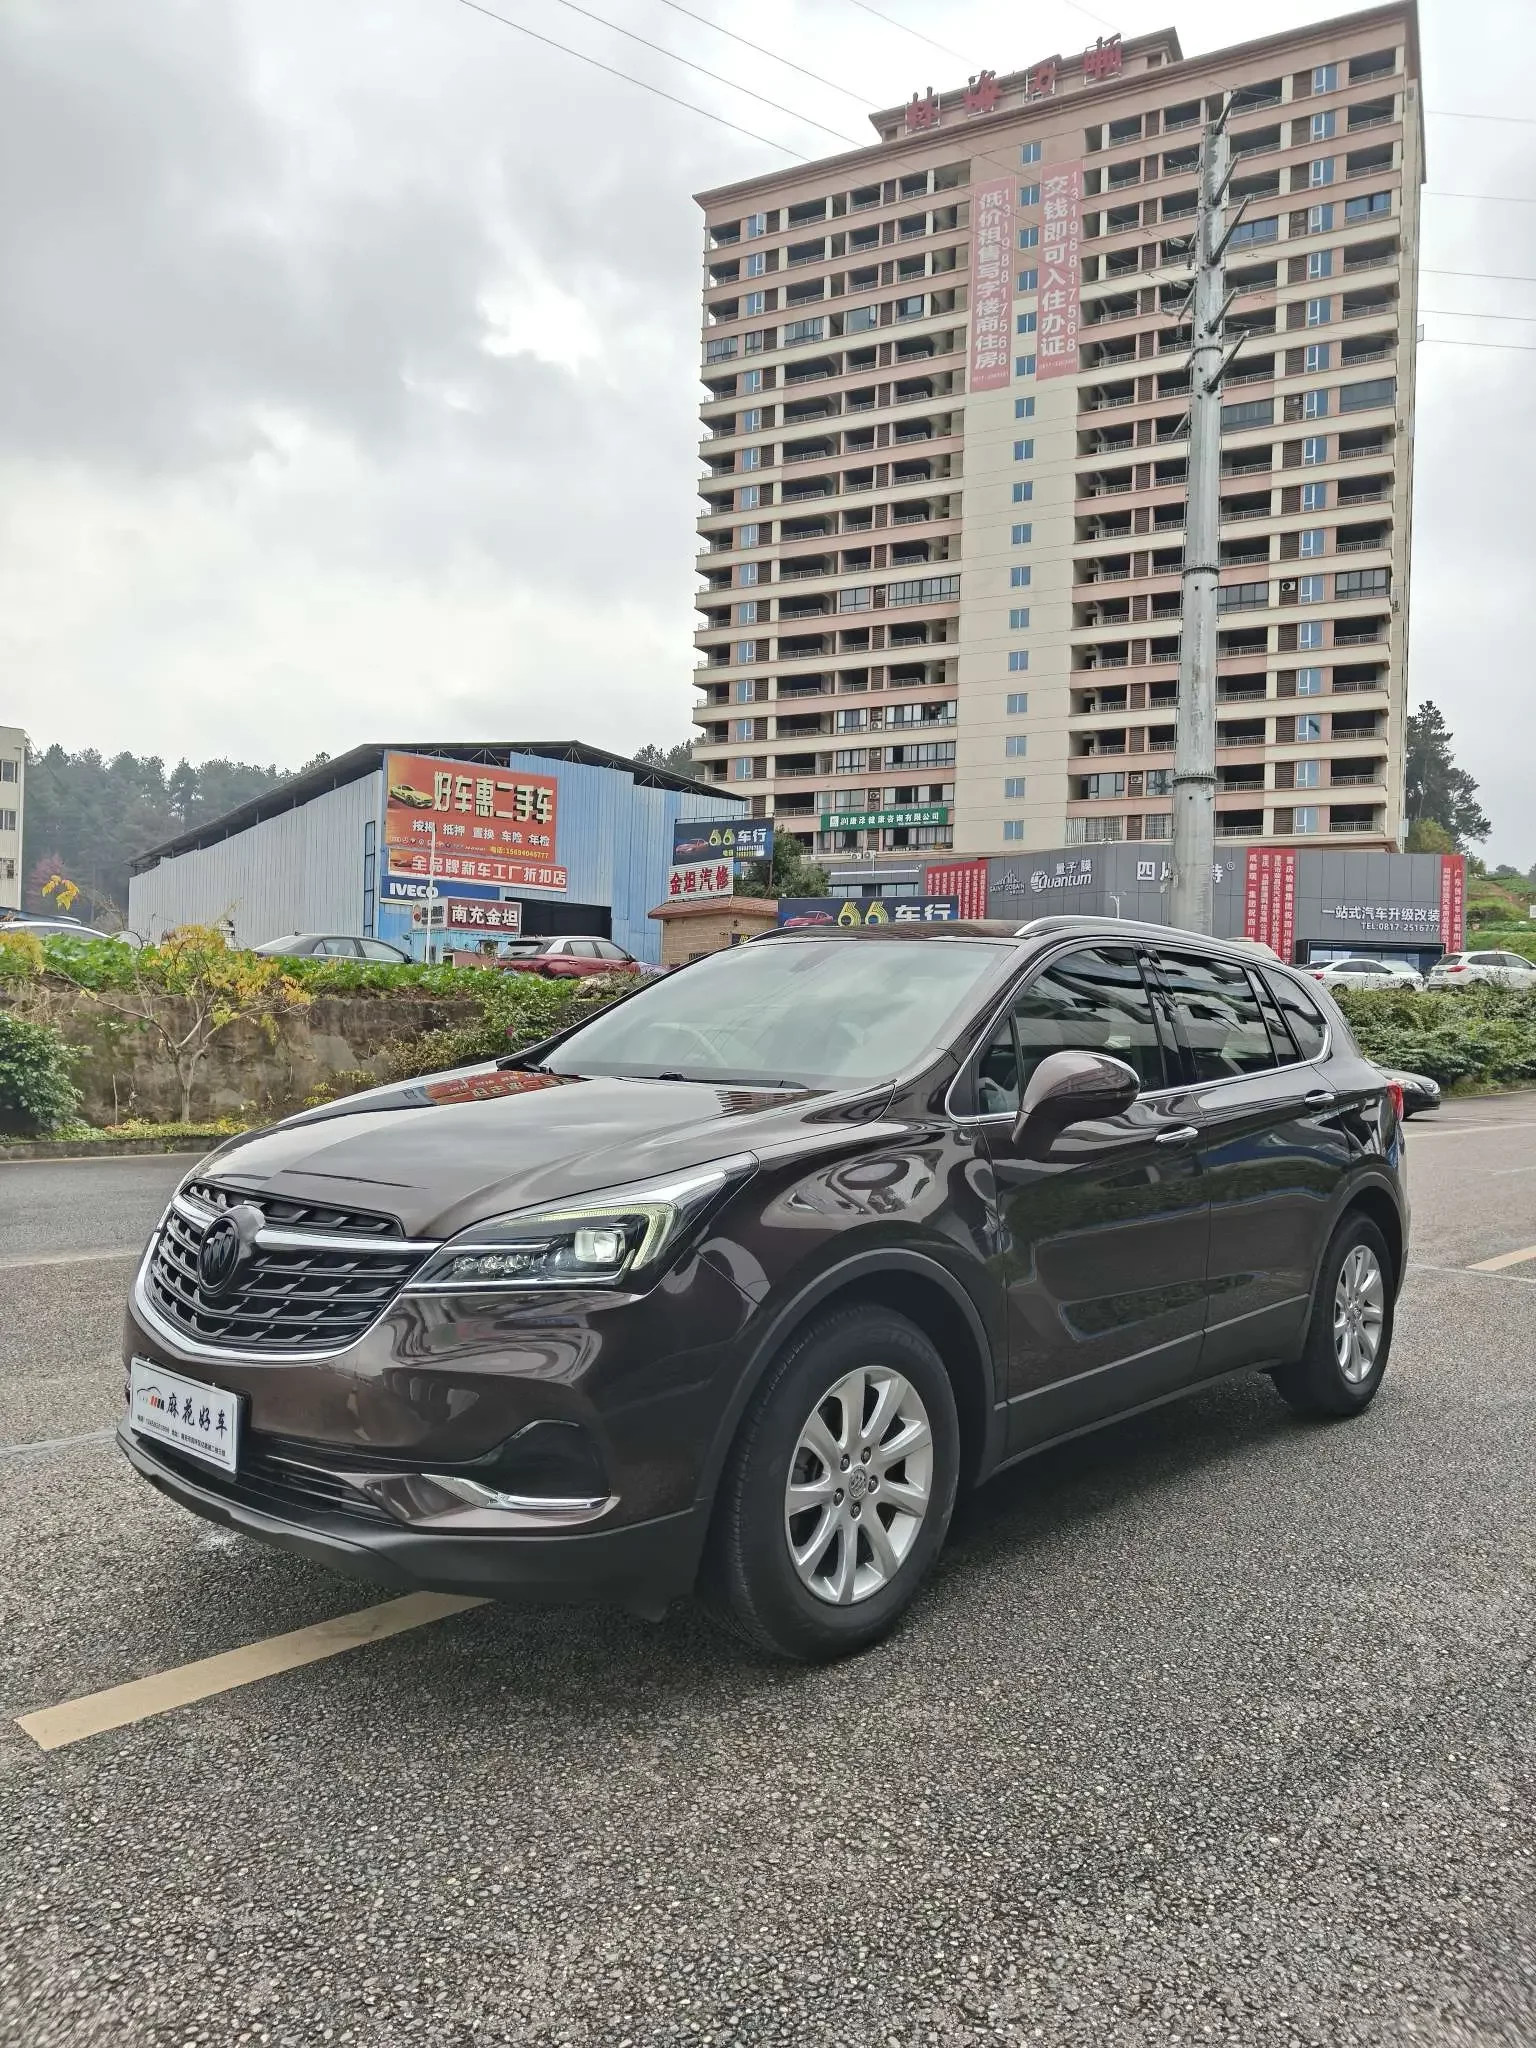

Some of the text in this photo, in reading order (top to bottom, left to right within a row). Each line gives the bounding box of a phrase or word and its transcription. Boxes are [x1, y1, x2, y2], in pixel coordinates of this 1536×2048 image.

[1041, 175, 1069, 358] 交钱即可入住办证
[1066, 171, 1079, 352] 13198817568
[974, 191, 1001, 369] 低价租售写字楼商住房
[998, 188, 1010, 366] 13198817568
[433, 771, 553, 825] 好车惠二手车
[442, 824, 465, 837] 抵押
[472, 826, 495, 840] 置换
[501, 830, 523, 844] 车险
[529, 834, 551, 847] 年检
[411, 855, 567, 886] 全品牌新车工厂折扣店
[670, 865, 729, 895] 金坦汽修
[1038, 873, 1091, 889] Quantum
[1056, 859, 1092, 875] 量子膜
[389, 883, 439, 898] IVECO
[451, 904, 519, 928] 南充金坦
[837, 900, 951, 926] 66车行
[1322, 904, 1440, 922] 一站式汽车升级改装
[166, 1392, 228, 1440] 麻花好车
